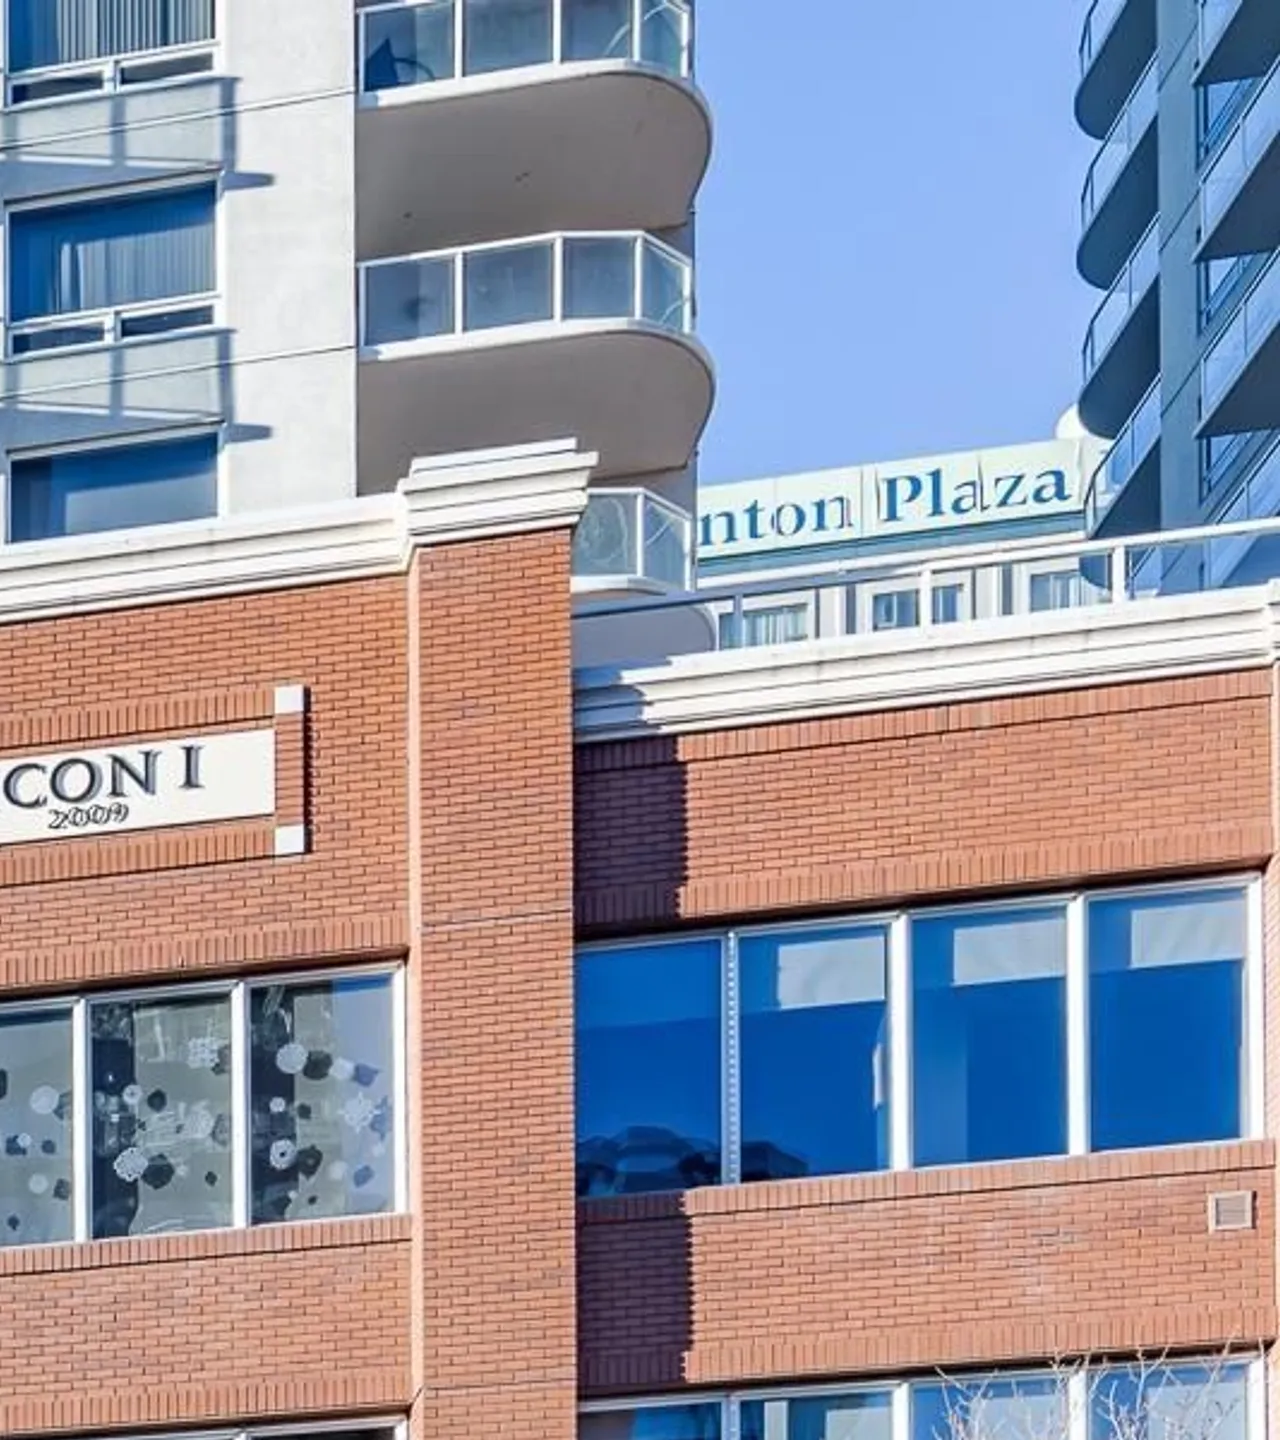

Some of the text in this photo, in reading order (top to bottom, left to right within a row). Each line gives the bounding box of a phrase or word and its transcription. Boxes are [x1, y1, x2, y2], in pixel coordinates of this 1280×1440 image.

[881, 468, 1073, 522] Plaza
[178, 744, 203, 789] I
[48, 801, 129, 830] 2009
